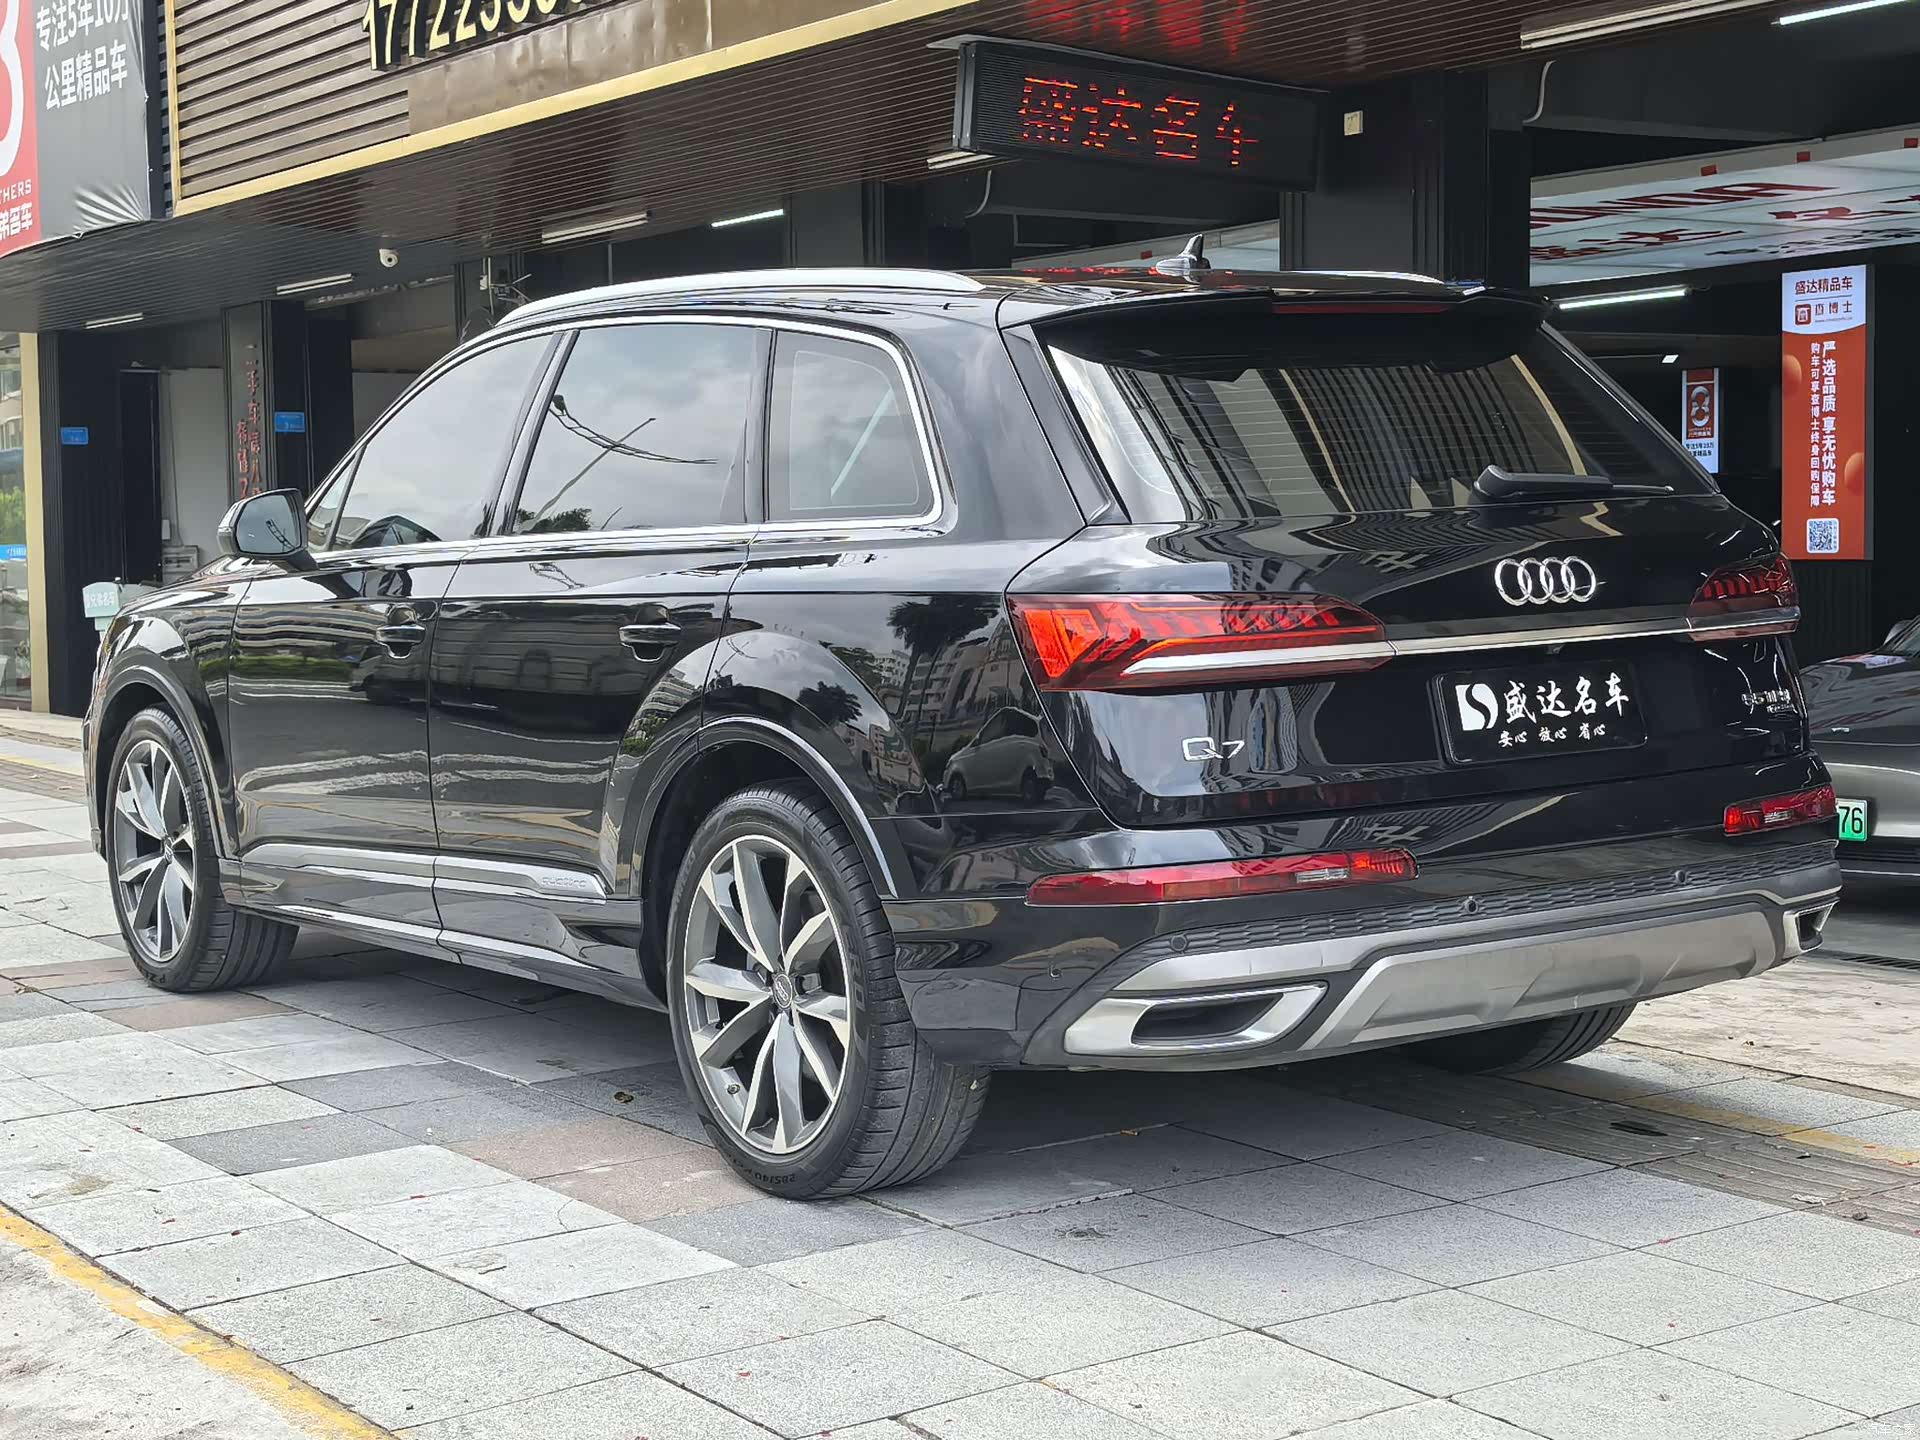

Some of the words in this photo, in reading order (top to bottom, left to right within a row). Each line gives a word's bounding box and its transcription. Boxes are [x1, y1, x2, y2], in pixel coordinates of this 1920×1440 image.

[44, 39, 128, 110] 公里精品车
[1795, 275, 1853, 295] 盛达精品车
[1822, 340, 1837, 412] 严选品质
[1822, 416, 1837, 506] 享无忧购车
[1503, 672, 1630, 724] 盛达名车
[1182, 736, 1245, 761] Q7
[1498, 730, 1528, 748] 安心
[1538, 726, 1568, 743] 放心
[1578, 722, 1606, 740] 省心
[1838, 806, 1863, 834] 76
